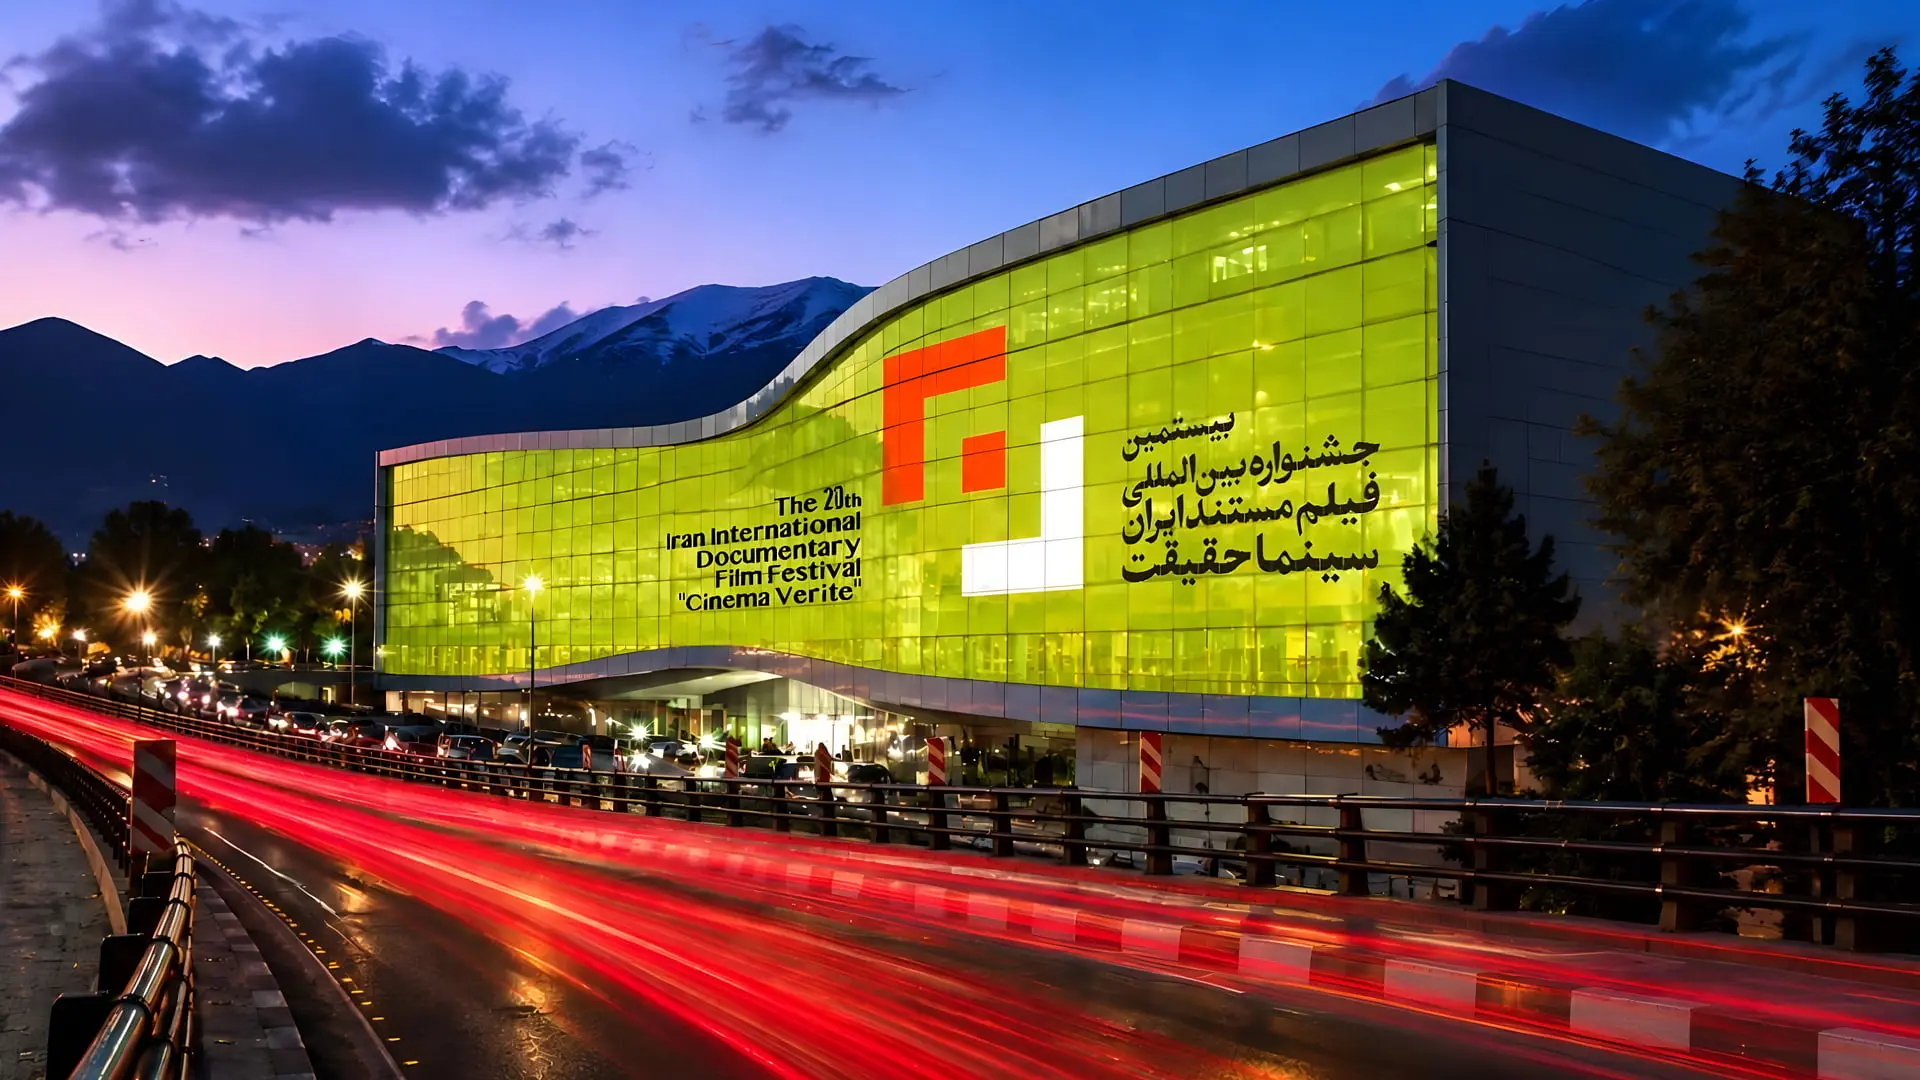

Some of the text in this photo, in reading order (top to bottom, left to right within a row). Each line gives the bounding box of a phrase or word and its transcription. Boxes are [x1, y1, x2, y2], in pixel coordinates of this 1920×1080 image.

[1122, 412, 1235, 462] بیستمین
[1122, 434, 1381, 508] جشنواره بین المللی
[774, 485, 862, 516] The 20th
[1122, 471, 1381, 545] فیلم مستند ایران
[666, 511, 861, 550] Iran International
[696, 537, 861, 569] Documentary
[715, 557, 861, 588] Film Festival
[1122, 533, 1379, 586] سینما حقیقت
[678, 577, 862, 612] "Cinema Verite"
